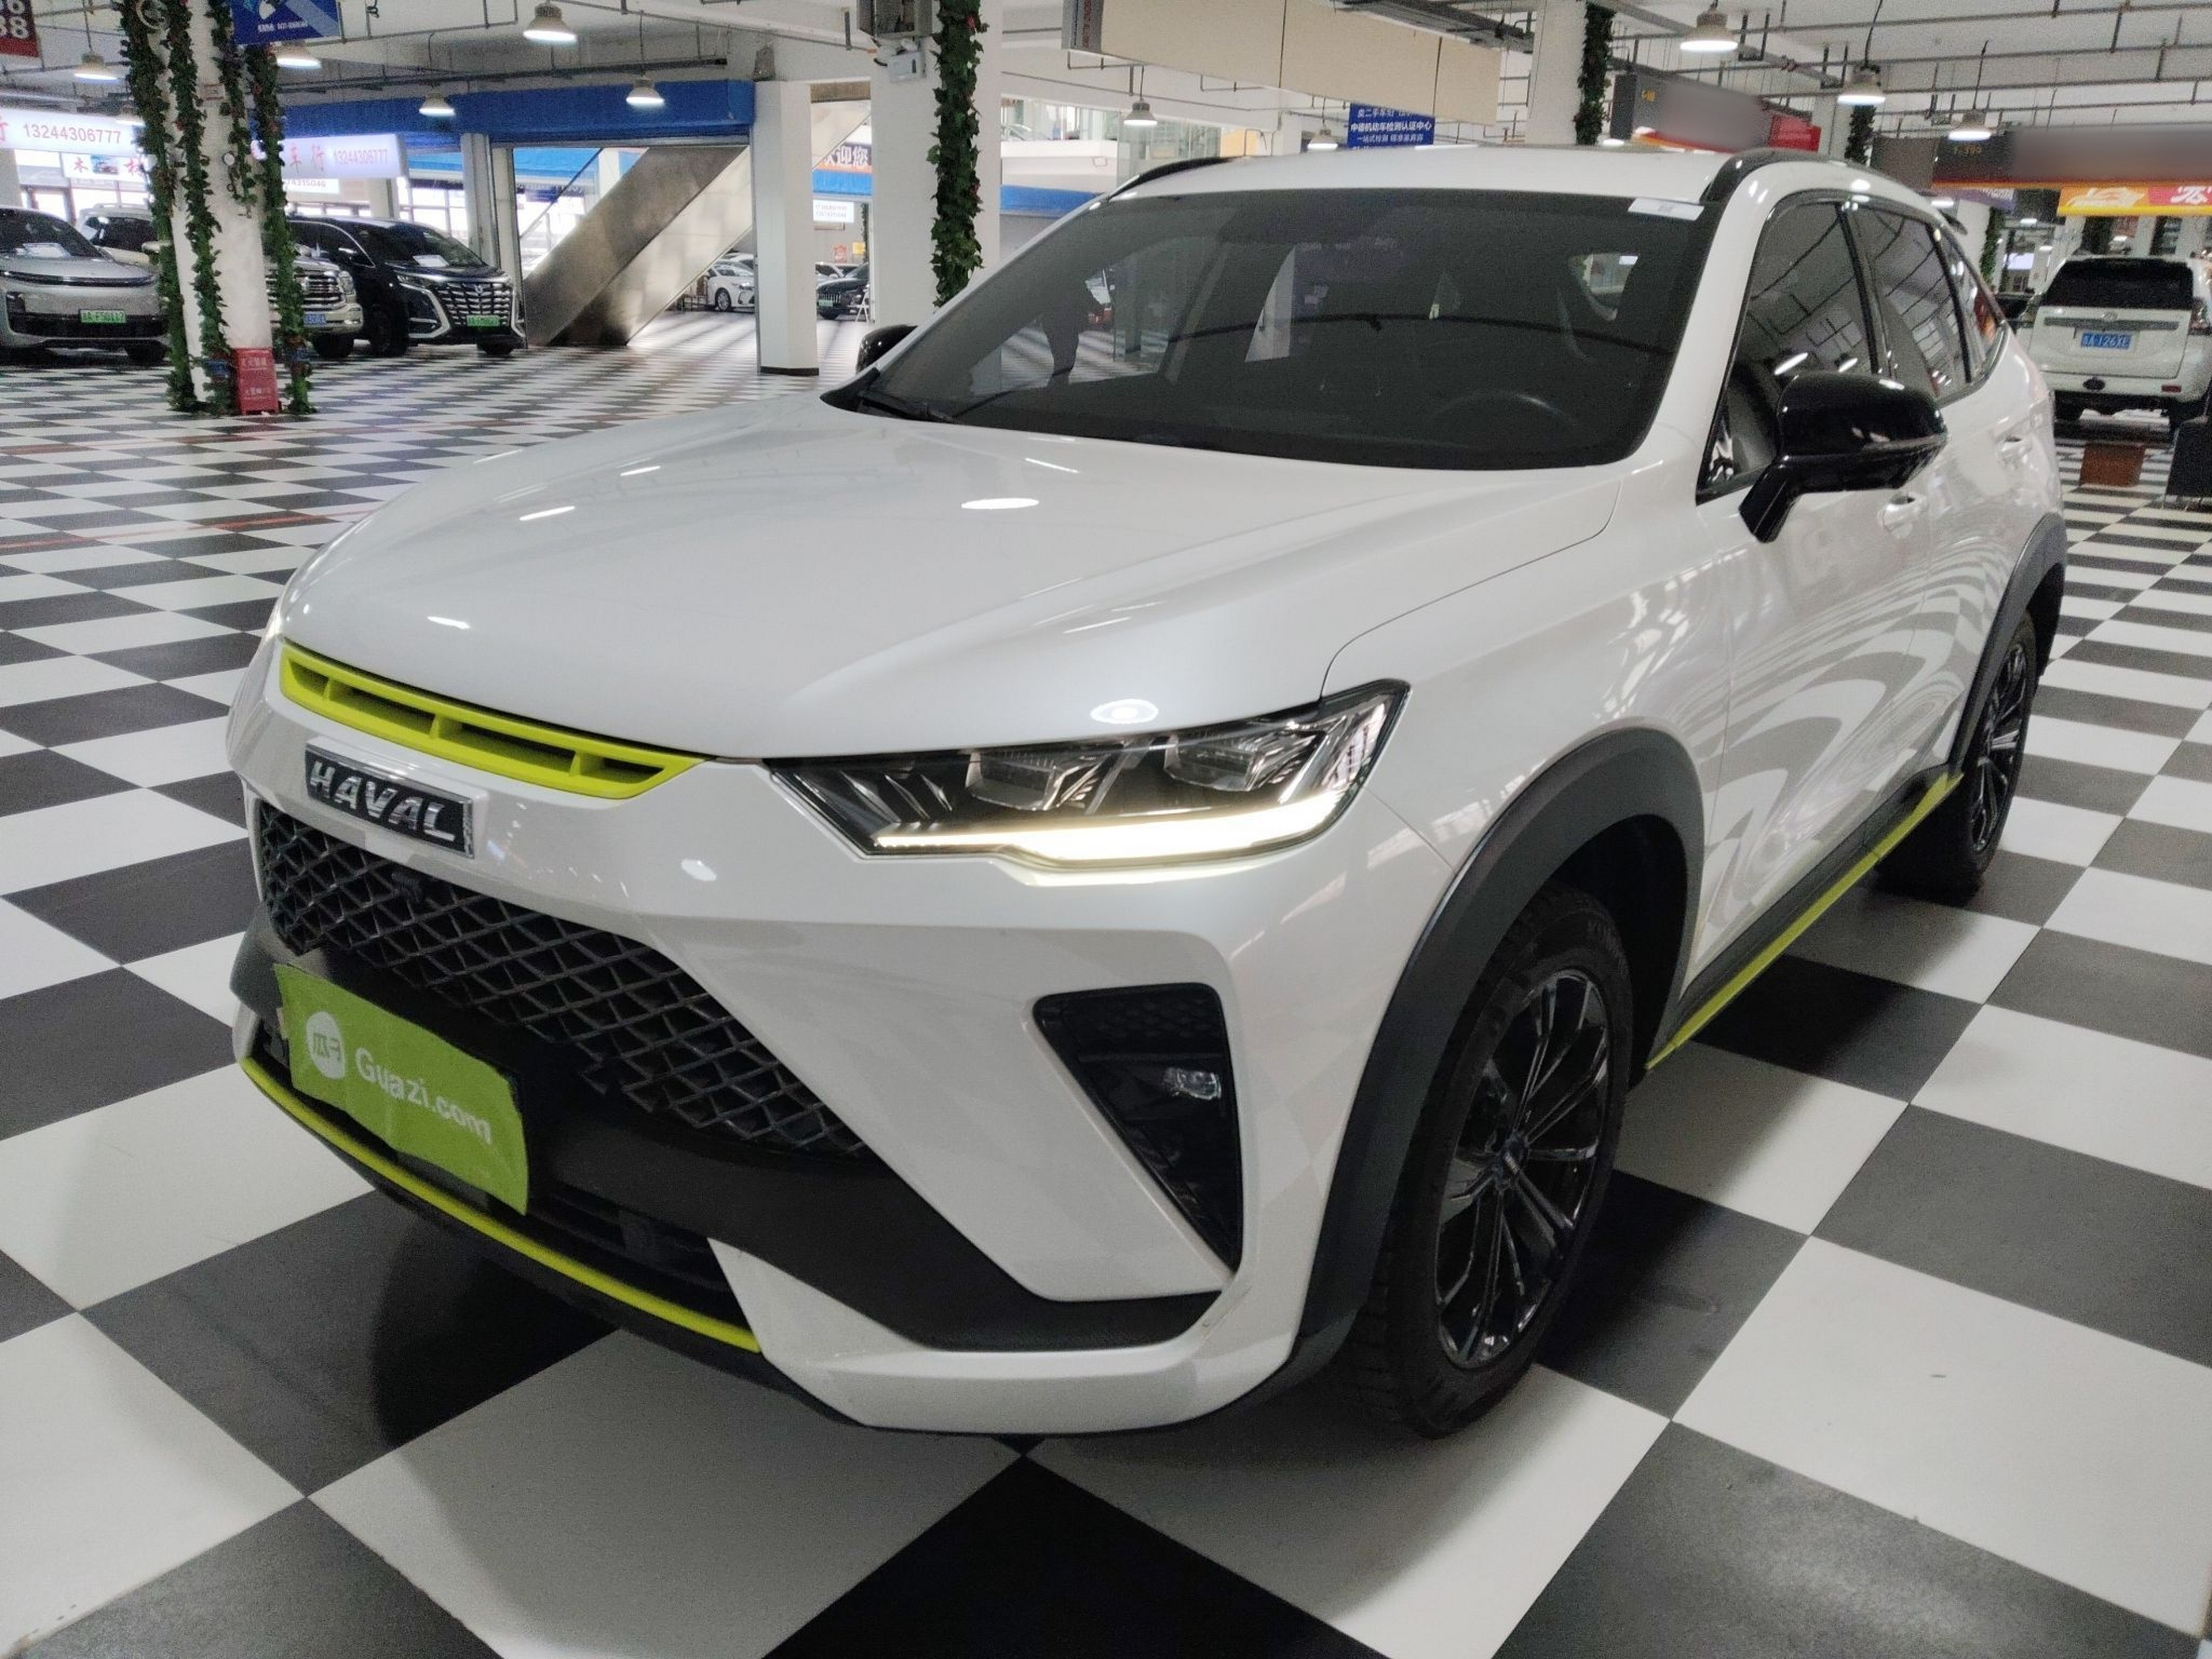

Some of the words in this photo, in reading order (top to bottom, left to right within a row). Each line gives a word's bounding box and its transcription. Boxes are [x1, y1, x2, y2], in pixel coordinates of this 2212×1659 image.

[23, 123, 122, 143] 13244306777
[334, 148, 388, 165] 13244306777
[309, 760, 455, 841] HAVAL
[354, 1046, 493, 1146] Guazi.com
